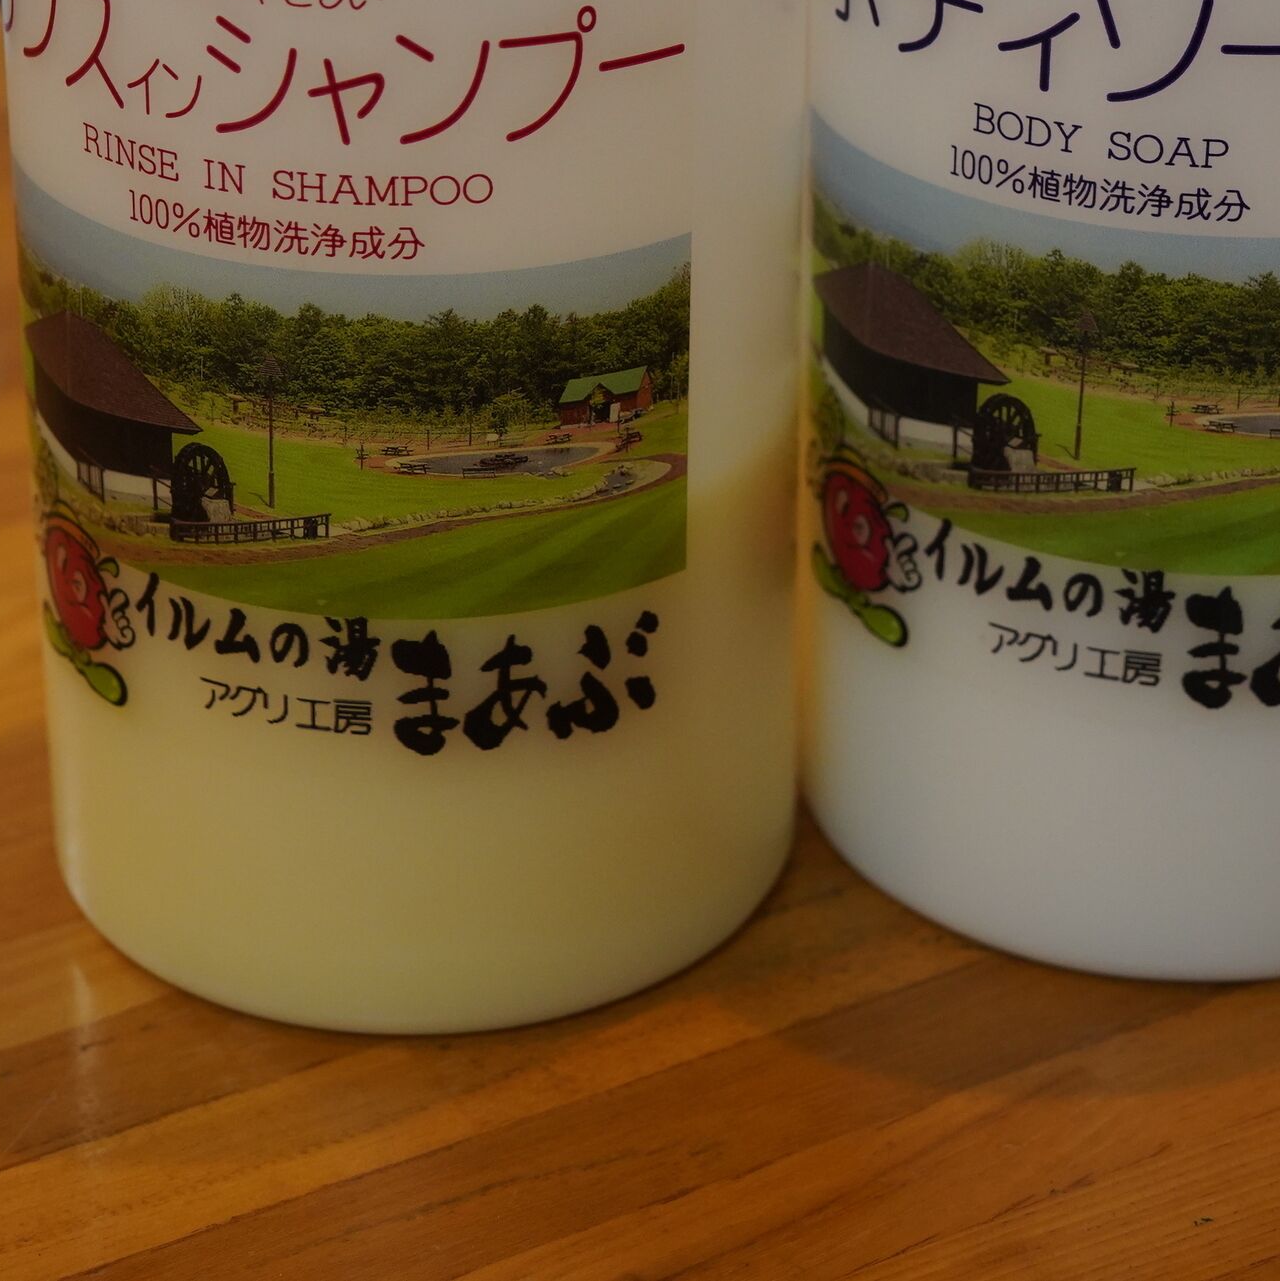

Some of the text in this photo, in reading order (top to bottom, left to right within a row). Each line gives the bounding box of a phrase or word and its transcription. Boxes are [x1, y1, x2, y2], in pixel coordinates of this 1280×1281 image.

[82, 122, 494, 208] RINSE IN SHAMPOO
[973, 103, 1230, 170] BODY SOAP
[949, 145, 1251, 222] 100%植物洗浄成分
[129, 189, 426, 261] 100%植物洗浄成分
[924, 520, 1176, 633] イルムの湯
[136, 573, 381, 682] イルムの湯
[988, 622, 1163, 687] アグリ工房
[200, 677, 374, 736] アグリ工房
[391, 611, 660, 756] まあぶ
